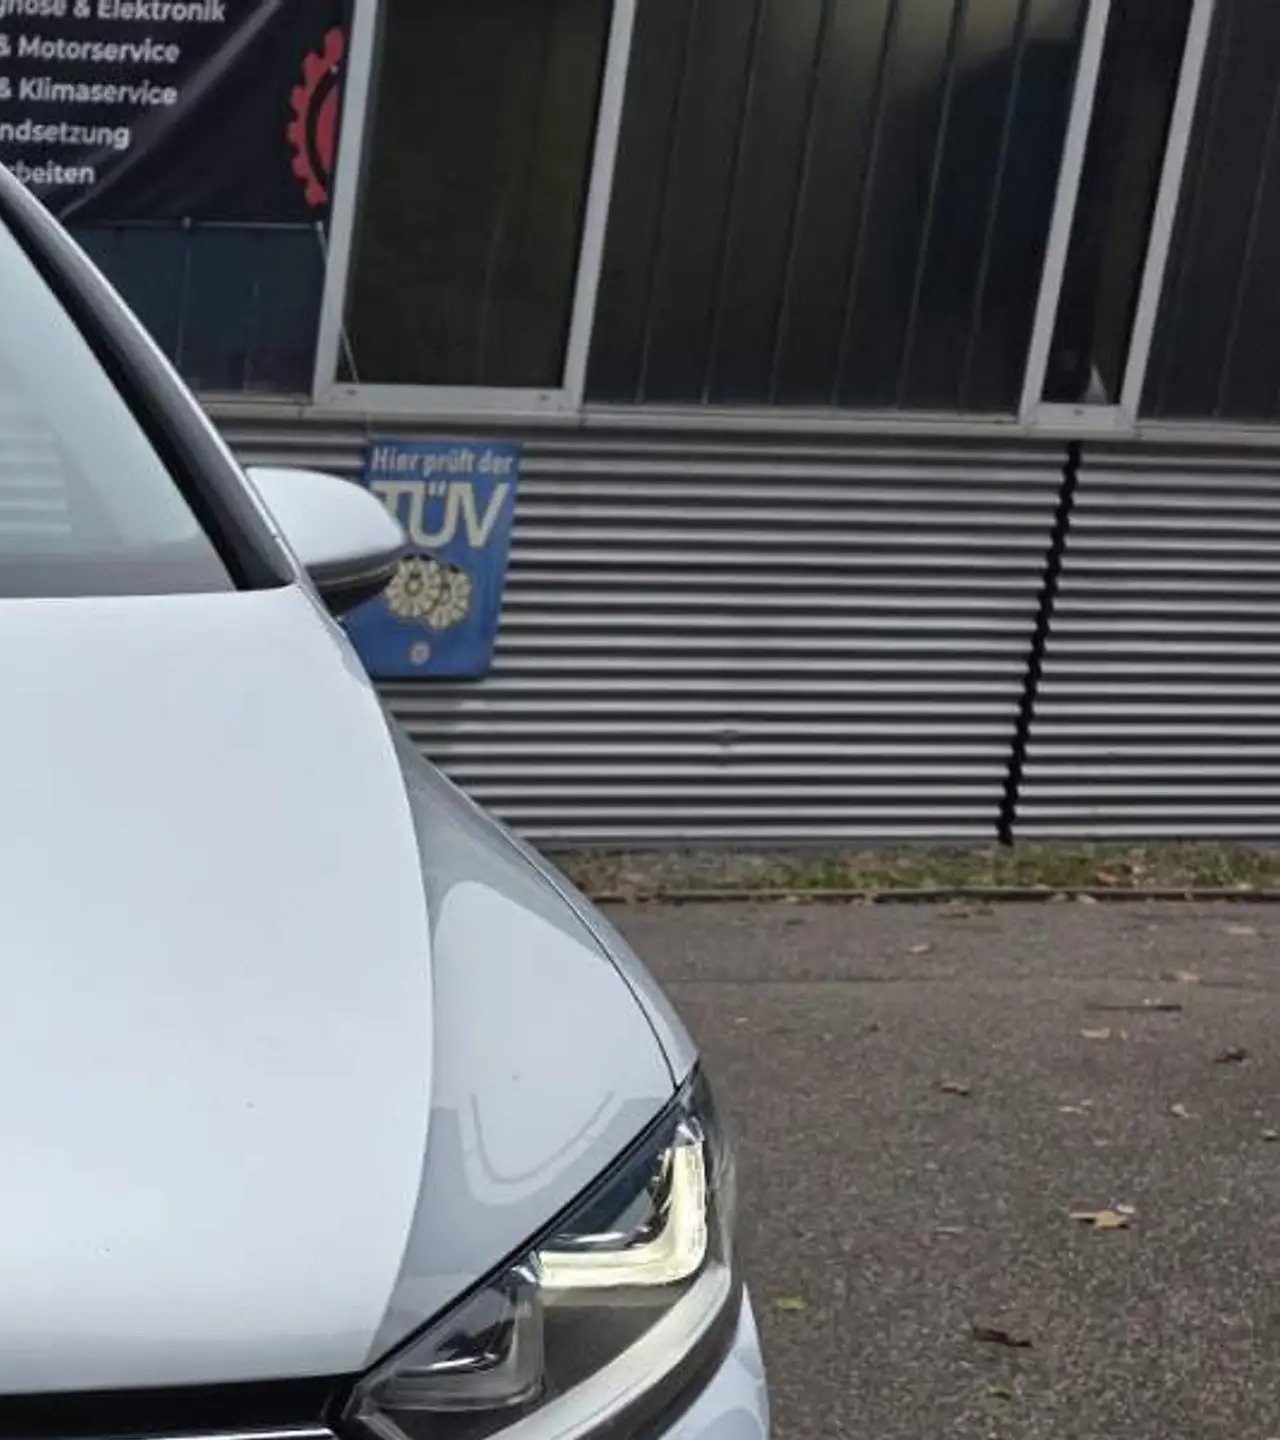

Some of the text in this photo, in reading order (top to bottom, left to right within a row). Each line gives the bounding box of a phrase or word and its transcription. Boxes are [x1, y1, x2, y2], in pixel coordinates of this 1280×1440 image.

[97, 0, 226, 22] Elektronik
[17, 36, 181, 64] Motorservice
[19, 78, 179, 106] Klimaservice
[13, 161, 95, 185] beiten
[371, 446, 514, 477] Hier prüft der
[370, 479, 510, 548] TÜV
